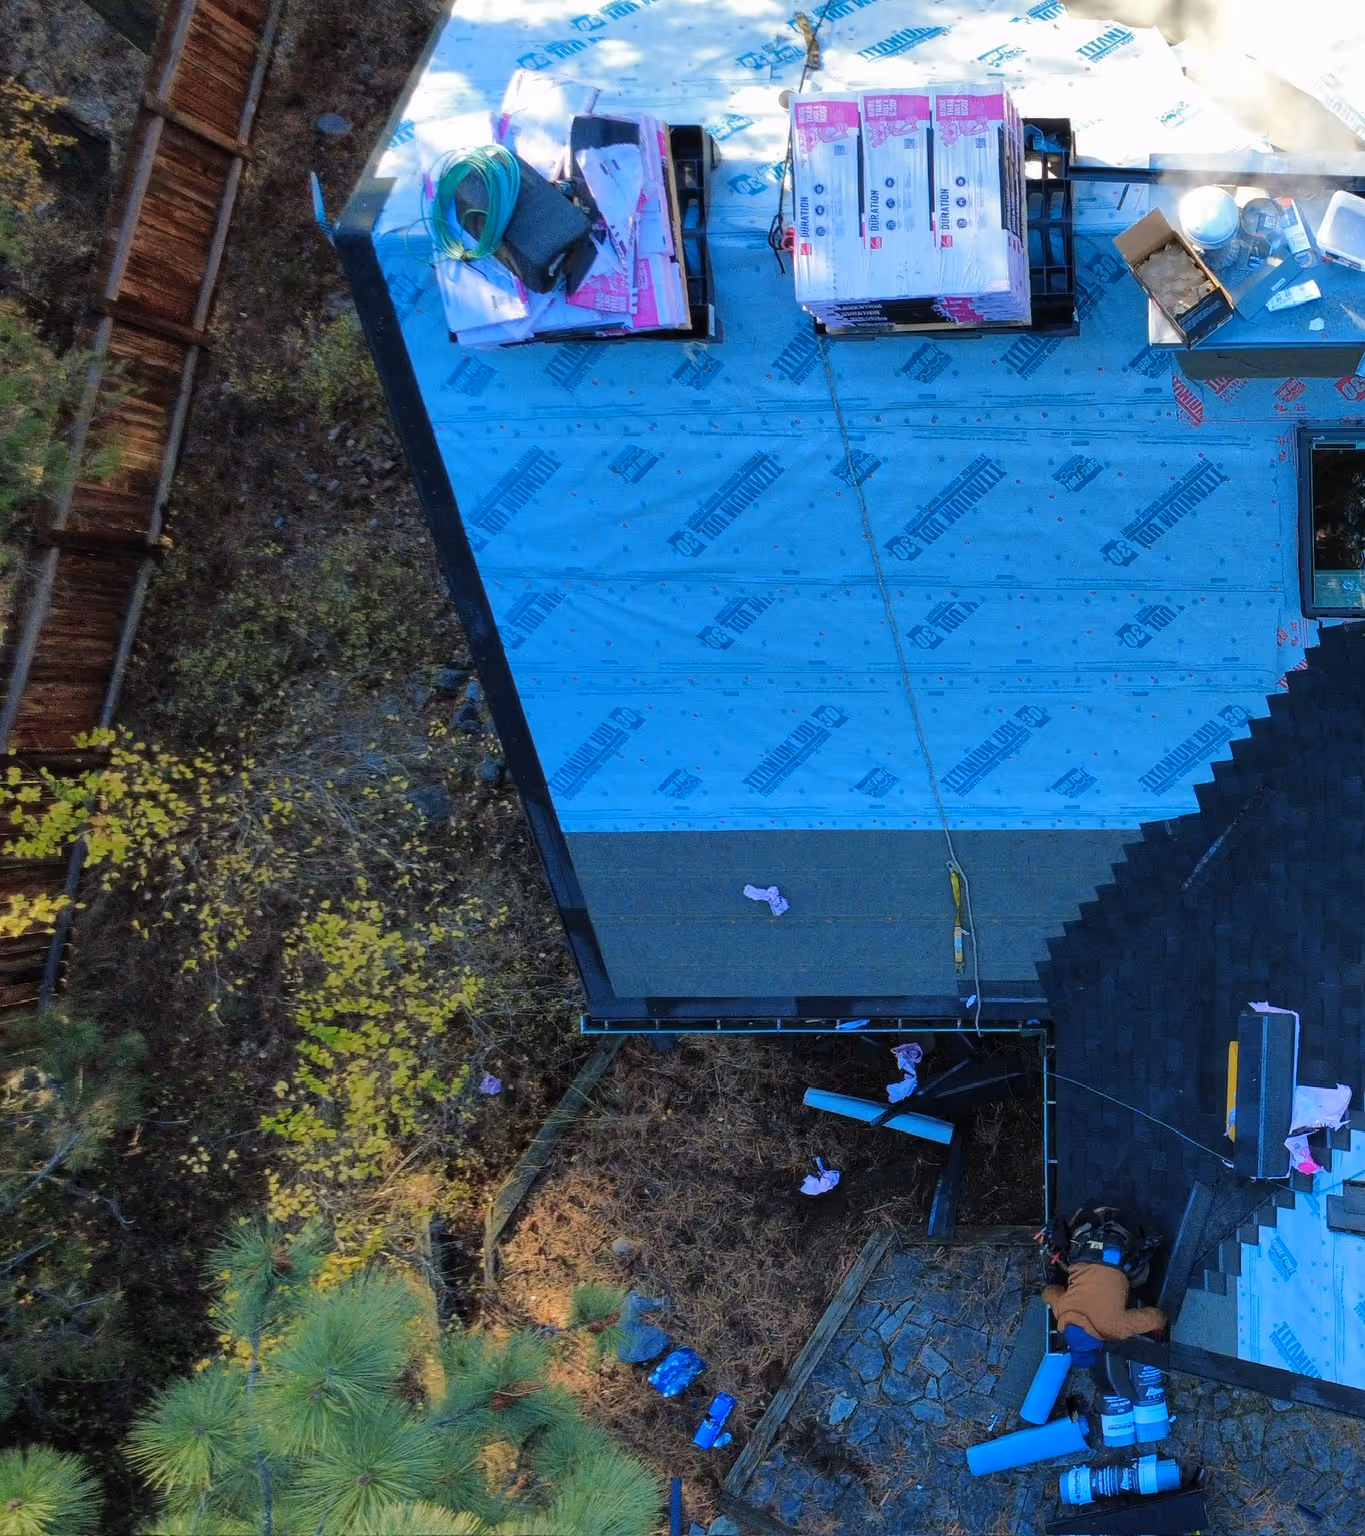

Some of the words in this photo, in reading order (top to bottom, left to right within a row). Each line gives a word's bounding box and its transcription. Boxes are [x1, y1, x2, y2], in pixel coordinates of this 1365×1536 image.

[1075, 27, 1128, 57] TITANI
[800, 196, 809, 238] DURATION
[870, 188, 880, 232] DURATION
[941, 187, 951, 230] DURATION
[1092, 254, 1119, 283] 30
[905, 360, 923, 381] SURE
[919, 345, 939, 365] FOOT
[1080, 456, 1100, 476] SURE
[719, 457, 786, 520] TITANIUM
[941, 462, 1008, 526] TITANIUM
[1158, 466, 1228, 529] TITANIUM
[934, 604, 967, 634] UDL
[743, 738, 801, 790] TITANIUM
[790, 719, 822, 744] UDL
[940, 739, 1000, 790] TITANIUM
[992, 719, 1025, 745] UDL
[1138, 739, 1200, 791] TITANIUM
[1192, 719, 1227, 745] UDL
